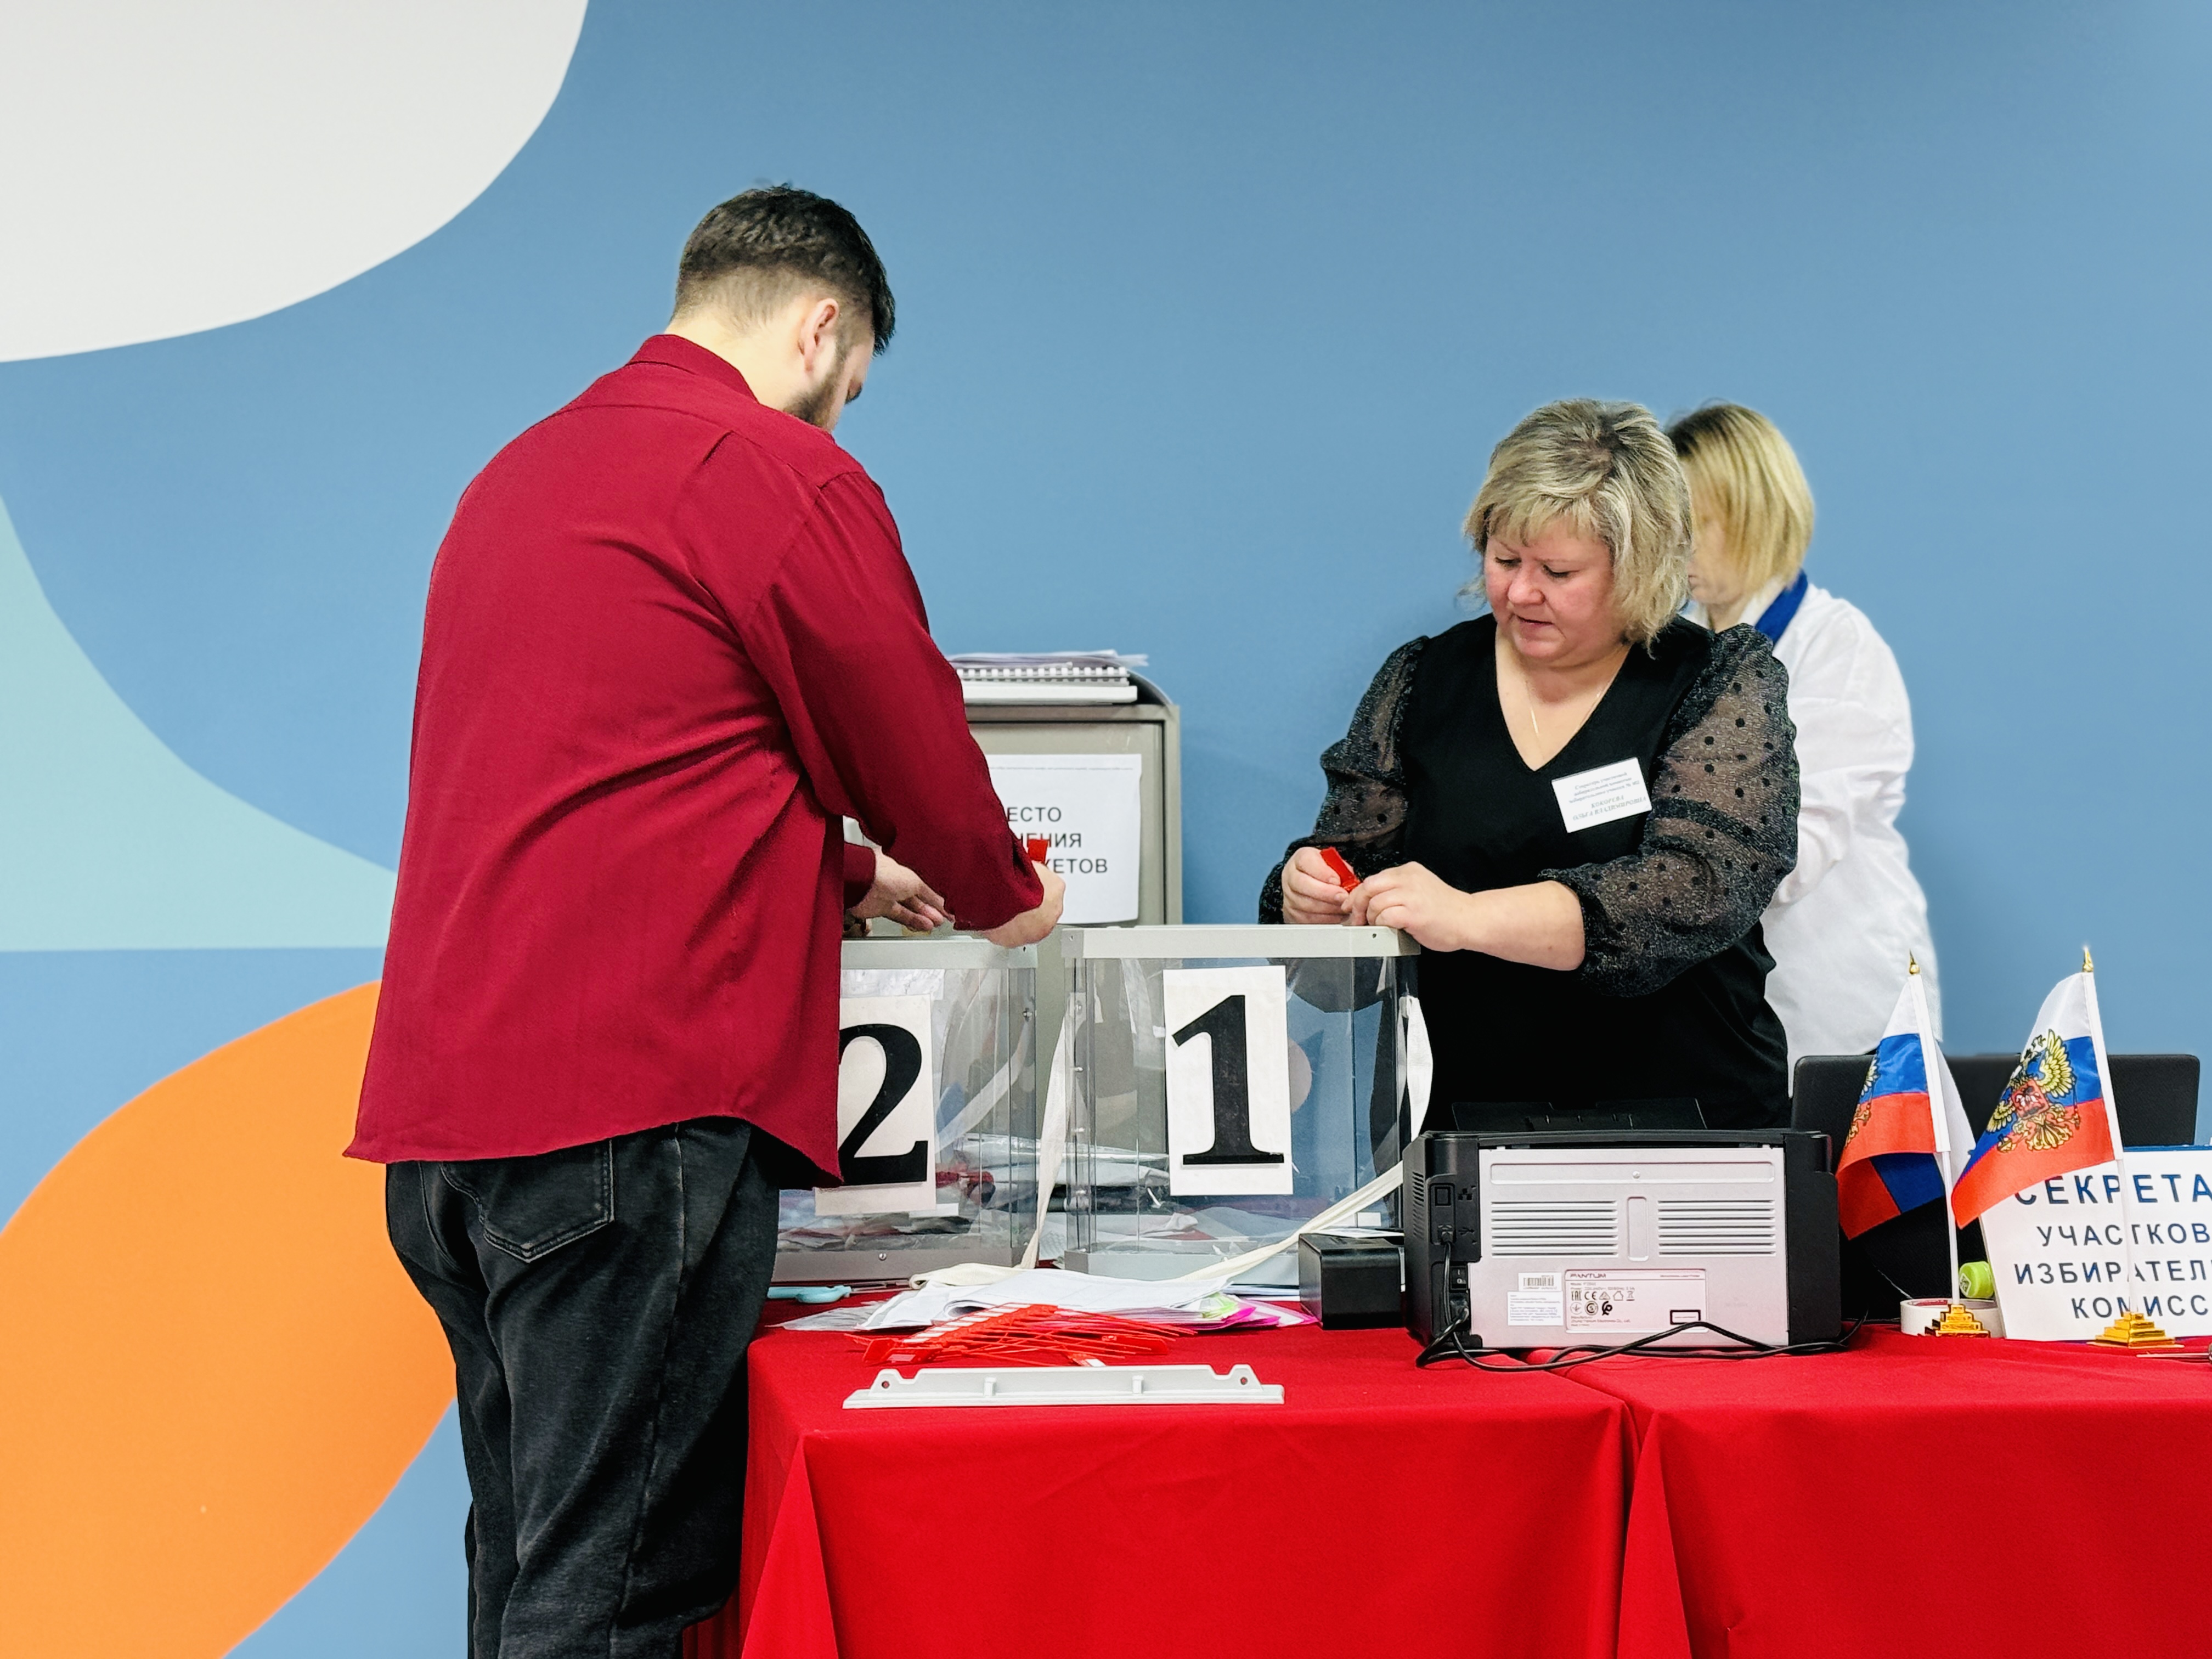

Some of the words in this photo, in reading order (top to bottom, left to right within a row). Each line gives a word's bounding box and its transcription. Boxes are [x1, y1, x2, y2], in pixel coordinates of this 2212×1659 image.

[839, 1023, 928, 1186] 2
[1171, 994, 1285, 1165] 1
[2014, 1260, 2212, 1284] ИЗБИРАТЕЛ
